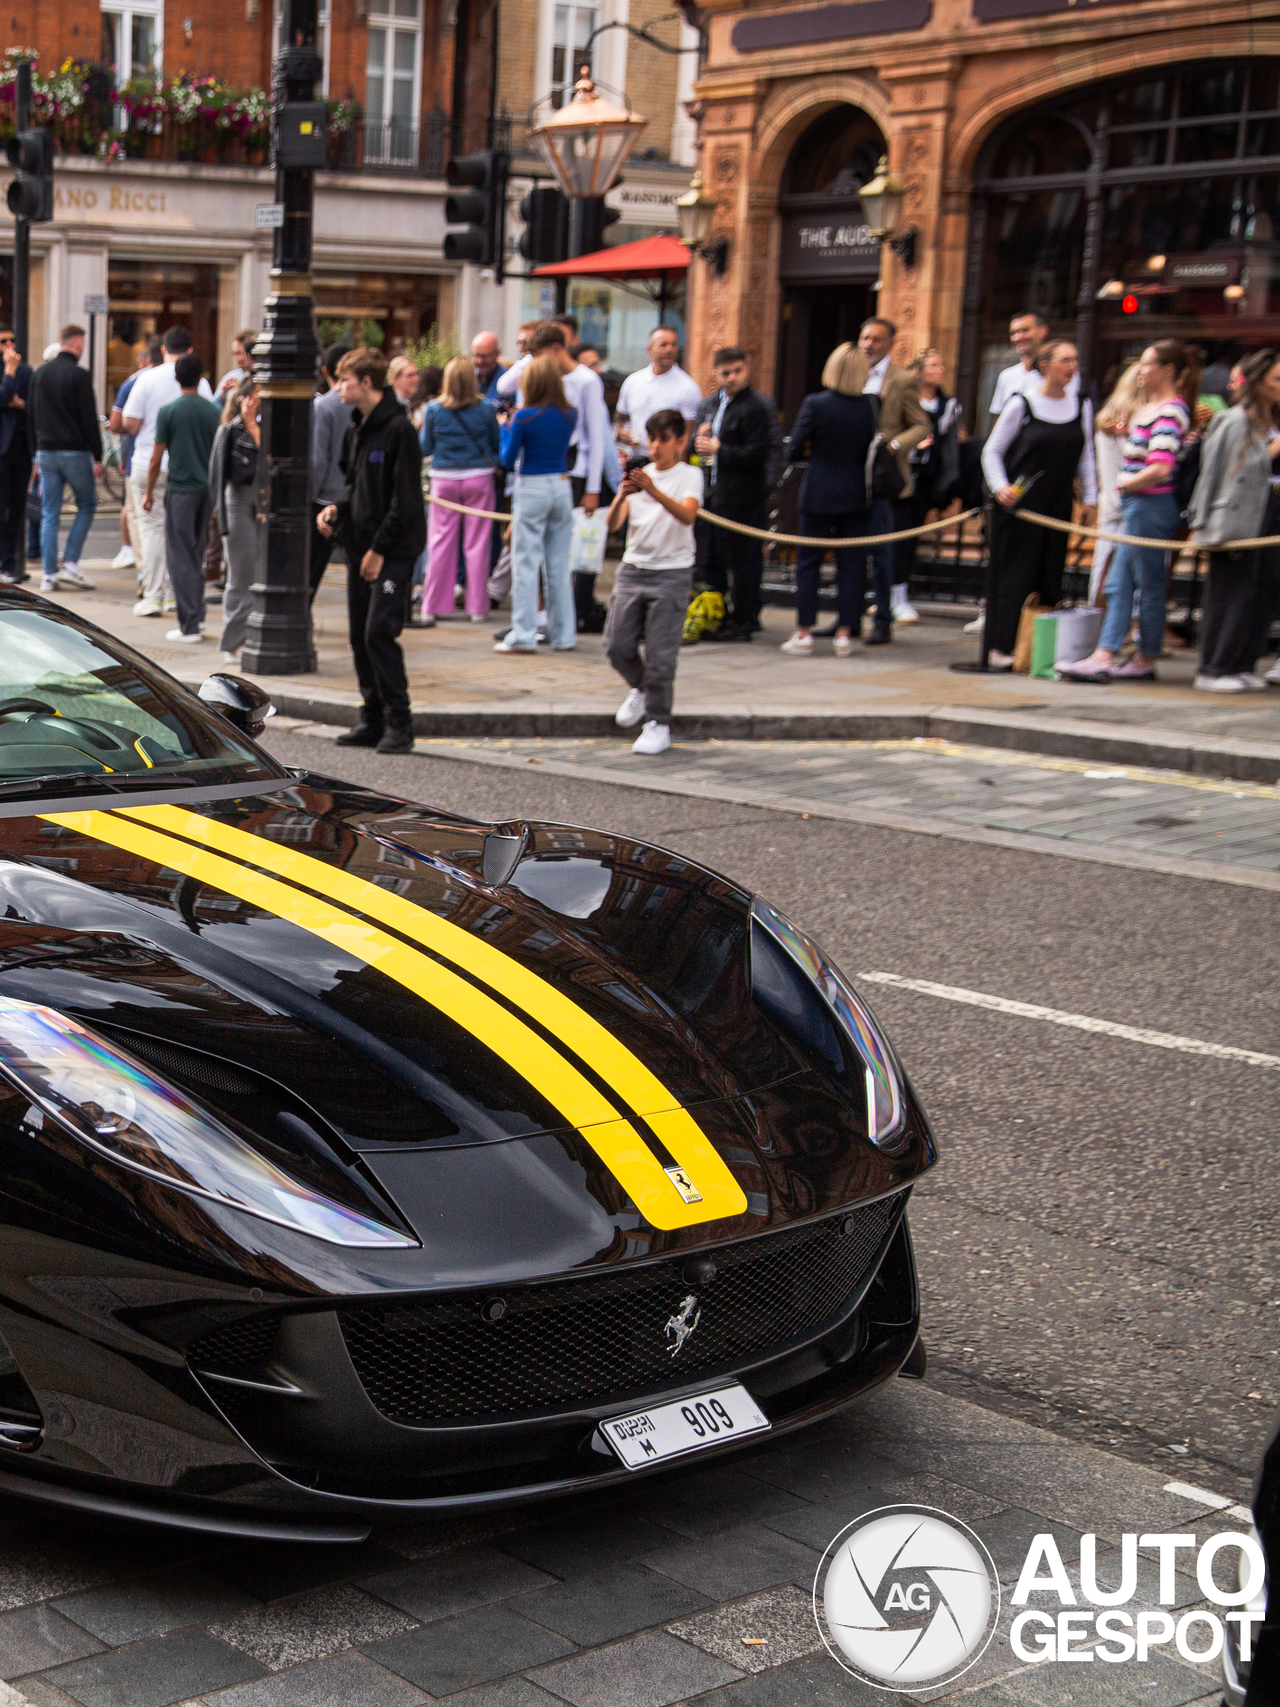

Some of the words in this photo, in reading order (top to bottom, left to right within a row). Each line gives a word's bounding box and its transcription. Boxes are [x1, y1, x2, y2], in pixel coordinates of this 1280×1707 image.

[109, 185, 167, 214] RICCI
[798, 226, 832, 248] THE
[681, 1398, 734, 1437] 909
[638, 1438, 658, 1457] M
